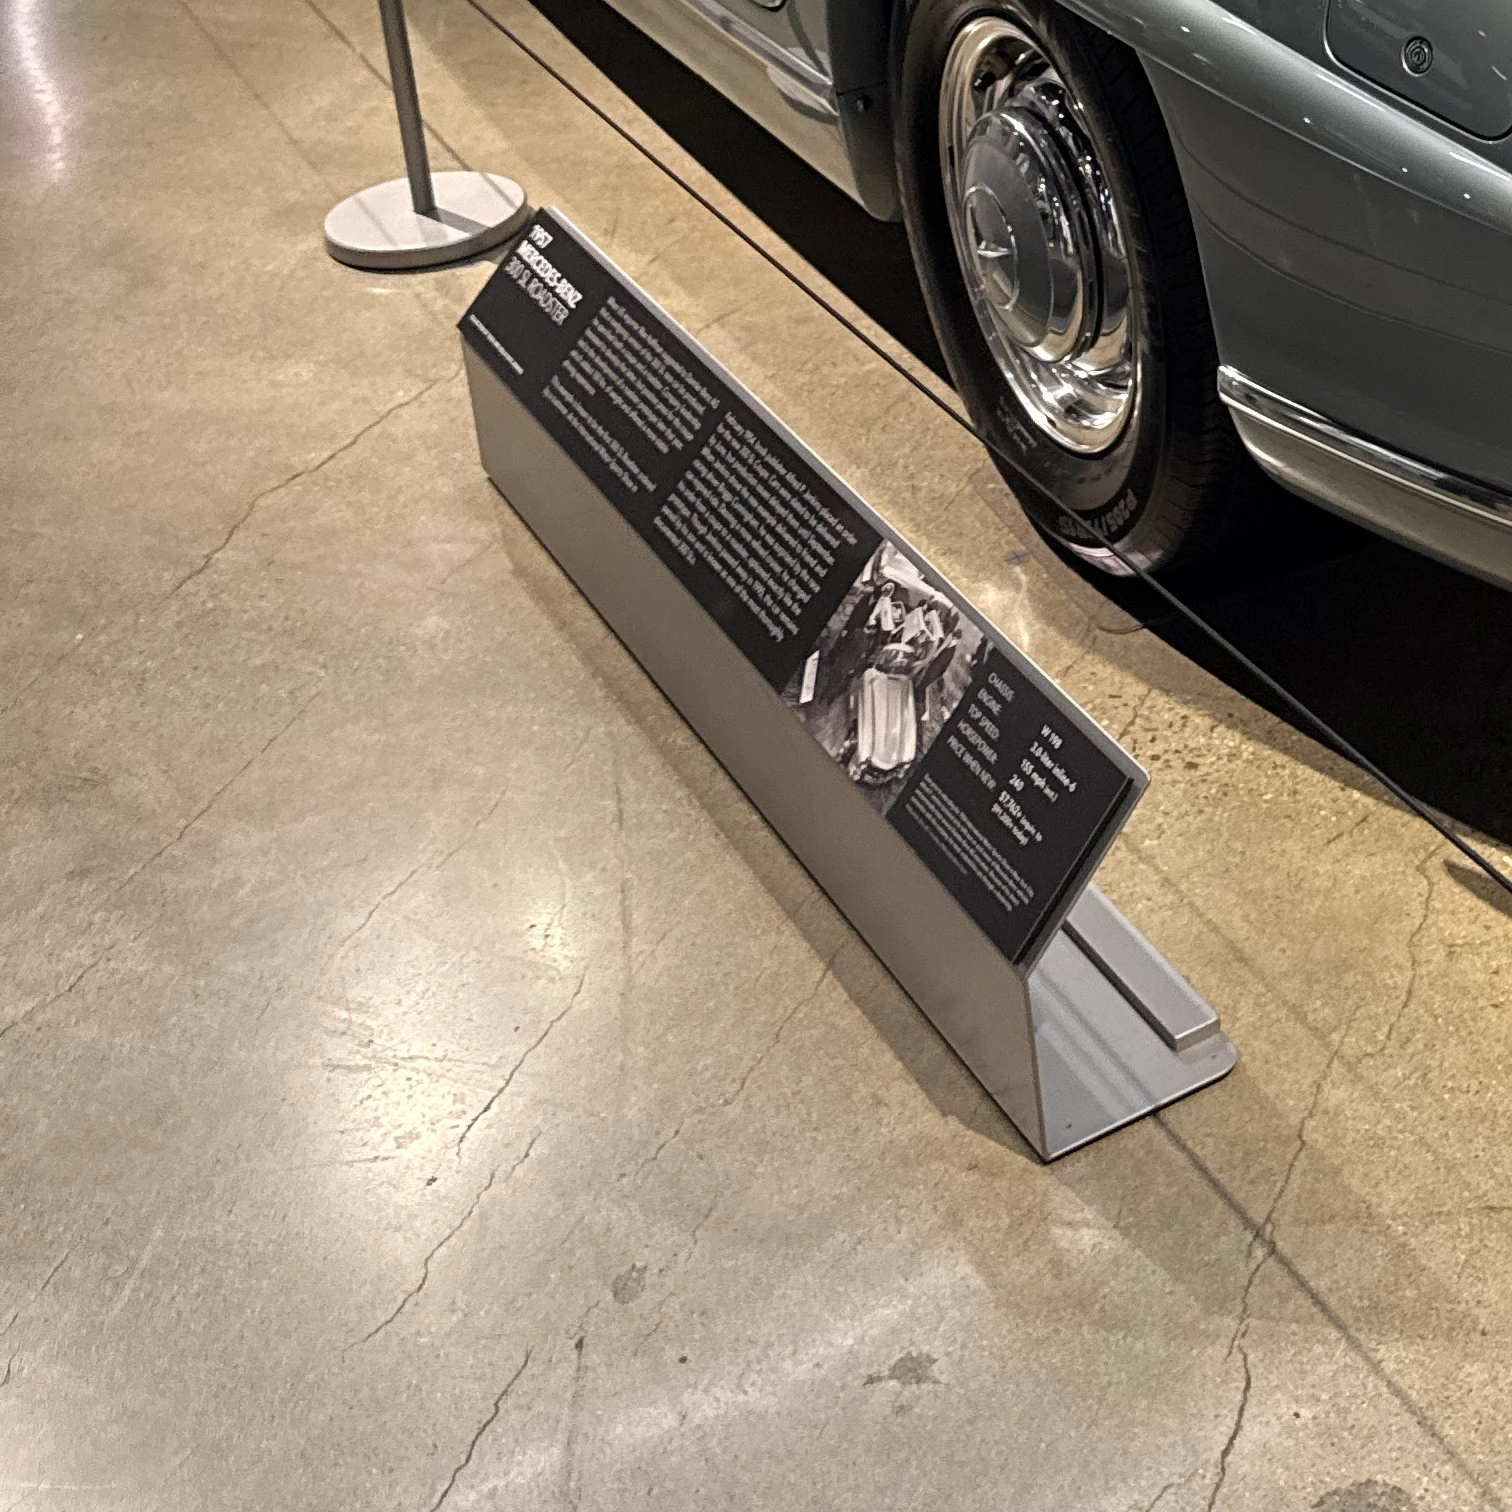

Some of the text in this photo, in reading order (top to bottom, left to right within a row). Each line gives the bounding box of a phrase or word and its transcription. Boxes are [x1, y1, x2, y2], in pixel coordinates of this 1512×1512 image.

[517, 239, 582, 308] MERCEDES-BENZ
[526, 277, 568, 325] ROADSTER
[967, 704, 981, 721] TOP
[947, 735, 964, 757] PRICE
[962, 751, 981, 775] WHEN
[1029, 769, 1046, 790] mph
